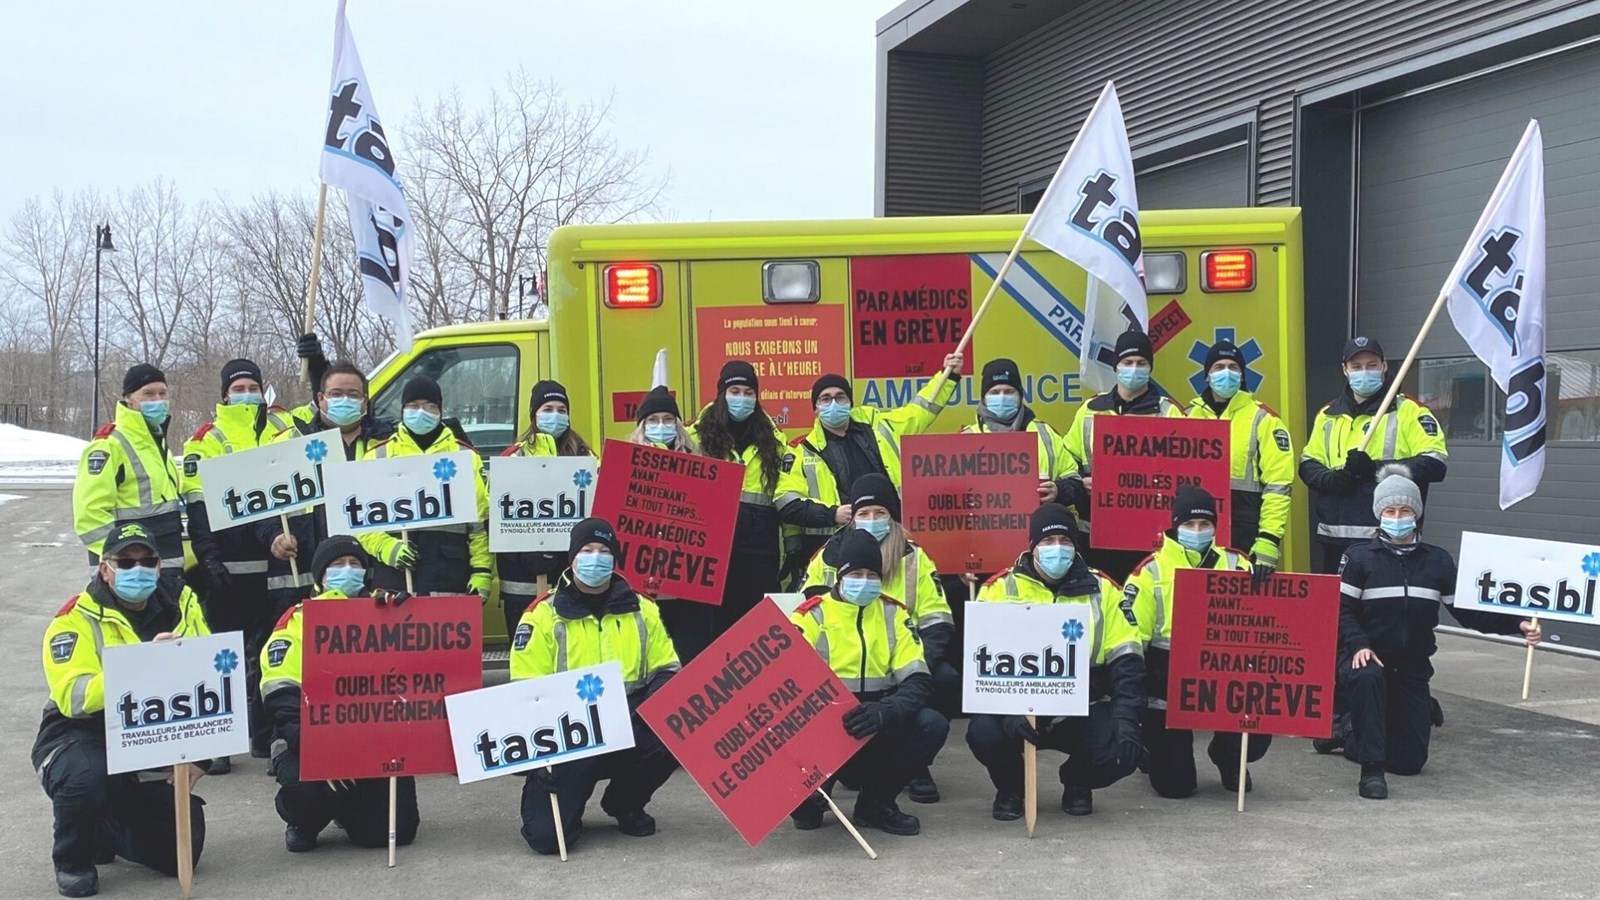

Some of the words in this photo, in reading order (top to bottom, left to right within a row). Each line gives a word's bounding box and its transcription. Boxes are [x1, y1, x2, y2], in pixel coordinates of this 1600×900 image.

[856, 284, 968, 312] PARAMÉDICS
[860, 320, 887, 346] EN
[894, 314, 963, 345] GRÈVE
[725, 341, 751, 356] NOUS
[754, 340, 802, 355] EXIGEONS
[804, 340, 818, 354] UN
[780, 389, 812, 400] d'intervent
[1103, 430, 1223, 460] PARAMÉDICS
[631, 447, 718, 481] ESSENTIELS
[911, 446, 1031, 477] PARAMÉDICS
[224, 463, 324, 519] tasbl
[1118, 469, 1173, 490] OUBLIÉS
[346, 483, 452, 526] tasbl
[500, 490, 585, 519] tasbl
[626, 496, 638, 508] EN
[641, 499, 663, 513] TOUT
[928, 488, 983, 510] OUBLIÉS
[986, 493, 1012, 509] PAR
[1098, 492, 1114, 508] LE
[617, 514, 707, 548] PARAMÉDICS
[909, 516, 926, 532] LE
[615, 539, 630, 571] N
[634, 544, 718, 588] GRÈVE
[1206, 573, 1309, 599] ESSENTIELS
[1478, 571, 1597, 615] tasbl
[314, 614, 471, 655] PARAMÉDICS
[1206, 628, 1220, 642] EN
[1224, 630, 1250, 643] TOUT
[976, 644, 1076, 677] tasbl
[1200, 650, 1306, 676] PARAMÉDICS
[335, 667, 408, 696] OUBLIÉS
[413, 672, 445, 694] PAR
[664, 624, 793, 742] PARAMÉDICS
[975, 680, 1024, 688] TRAVAILLEURS
[120, 676, 232, 727] tasbl
[1179, 678, 1218, 713] EN
[1226, 675, 1323, 719] GRÈVE
[121, 725, 177, 740] TRAVAILLEURS
[177, 717, 233, 733] AMBULANCIERS
[309, 703, 330, 726] LE
[713, 703, 775, 760] OUBLIÉS
[768, 677, 803, 712] PAR
[171, 732, 181, 741] DE
[184, 729, 215, 739] BEAUCE
[218, 726, 234, 735] INC.
[477, 704, 604, 768] tasbl
[711, 770, 738, 800] LE
[733, 679, 840, 781] GOUVERNEMENT
